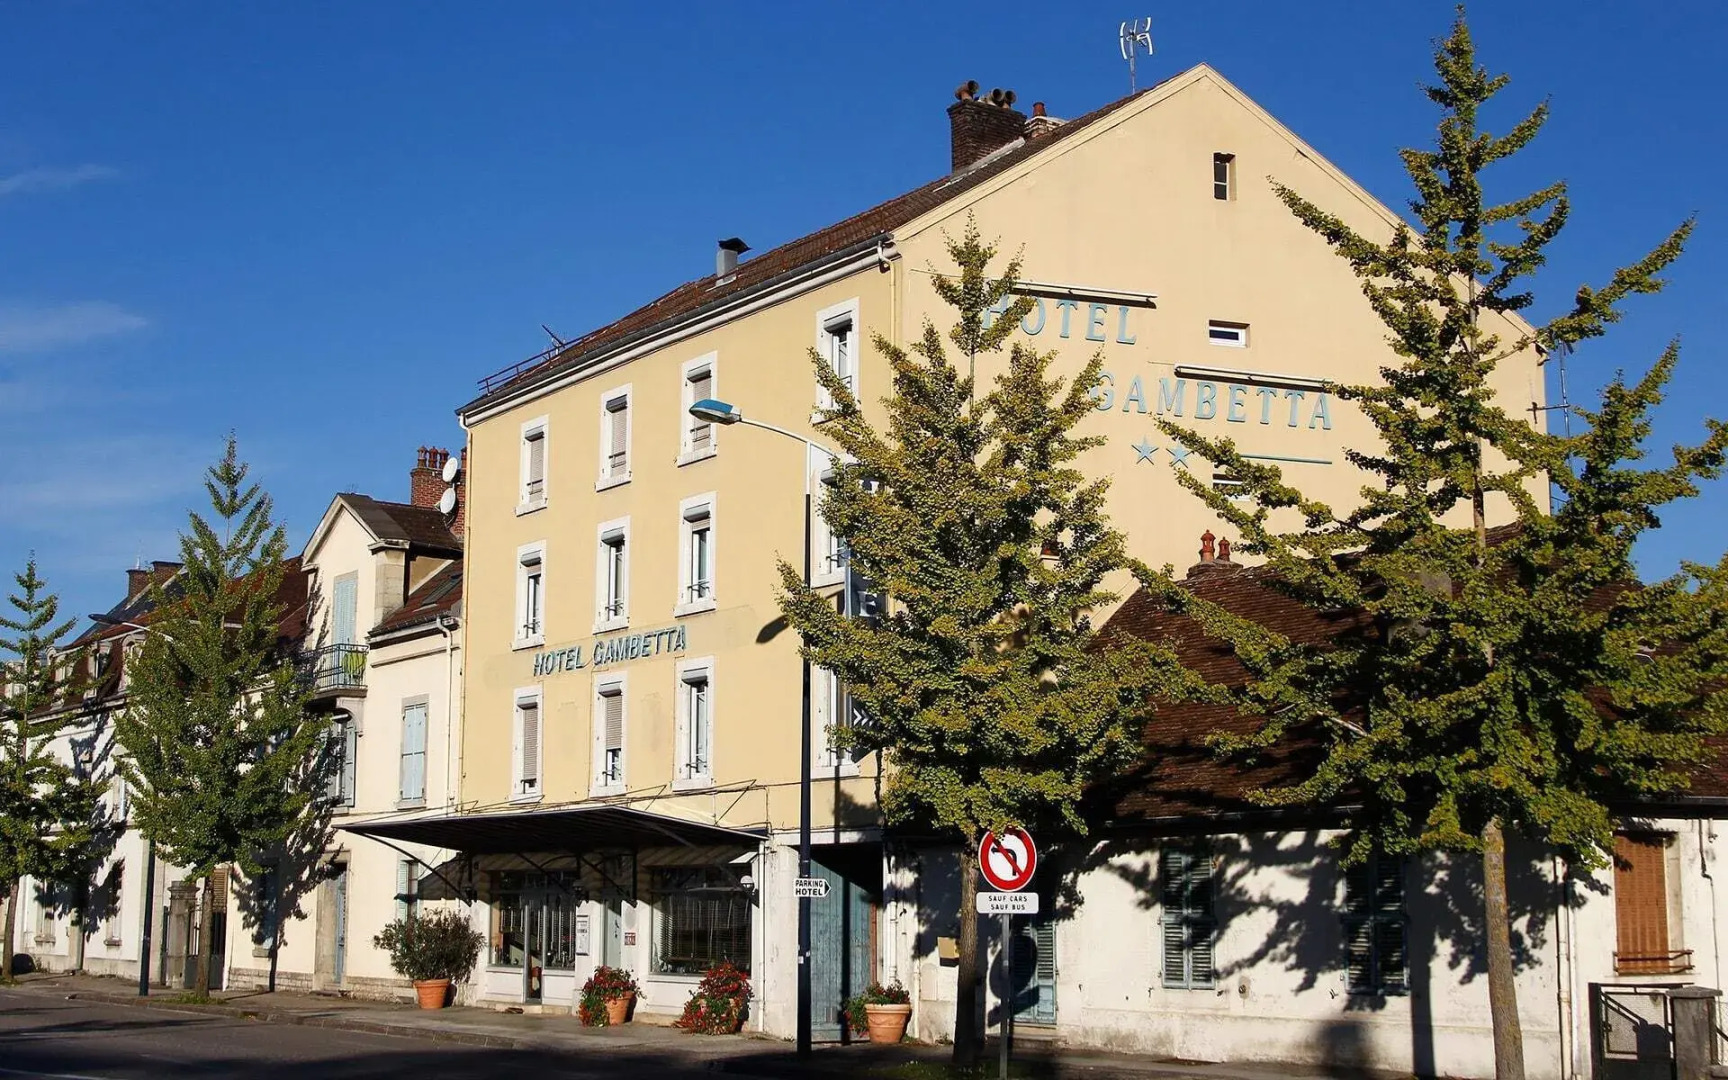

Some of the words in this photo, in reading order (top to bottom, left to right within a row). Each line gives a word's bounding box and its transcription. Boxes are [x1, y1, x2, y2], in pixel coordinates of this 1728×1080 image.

[1089, 369, 1333, 430] GAMBETTA
[533, 645, 584, 677] HOTEL
[593, 624, 687, 667] GAMBETTA
[795, 879, 824, 888] PARKING
[795, 888, 824, 896] HOTEL
